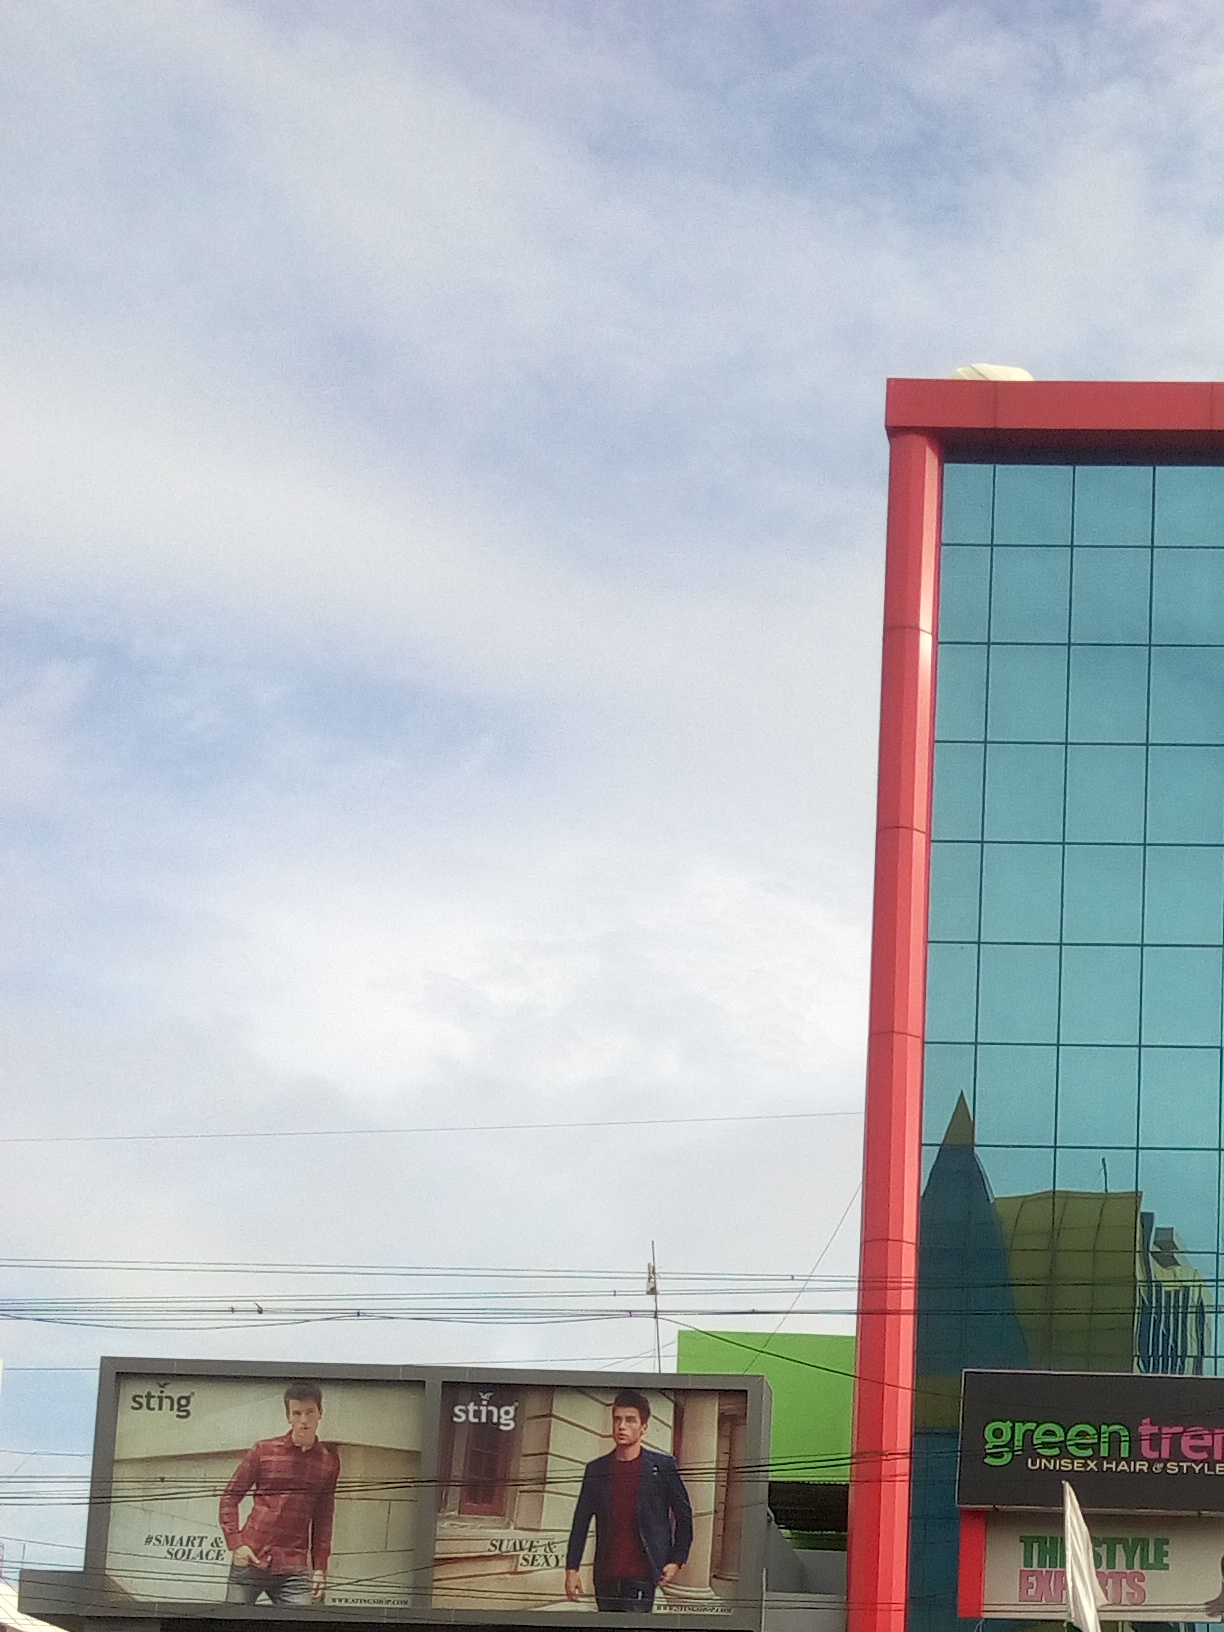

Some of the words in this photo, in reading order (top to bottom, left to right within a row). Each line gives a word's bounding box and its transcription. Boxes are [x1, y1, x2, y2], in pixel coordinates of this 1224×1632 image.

[131, 1388, 193, 1420] sting
[453, 1397, 517, 1431] sting
[984, 1418, 1131, 1467] green
[1028, 1457, 1098, 1472] UNISEX
[1103, 1459, 1148, 1473] HAIR
[144, 1534, 209, 1549] #SMART
[211, 1535, 224, 1549] &
[488, 1538, 539, 1554] SUAVE
[166, 1548, 226, 1562] SOLACE
[520, 1554, 566, 1568] SEXY
[1019, 1569, 1147, 1606] EXPRTS
